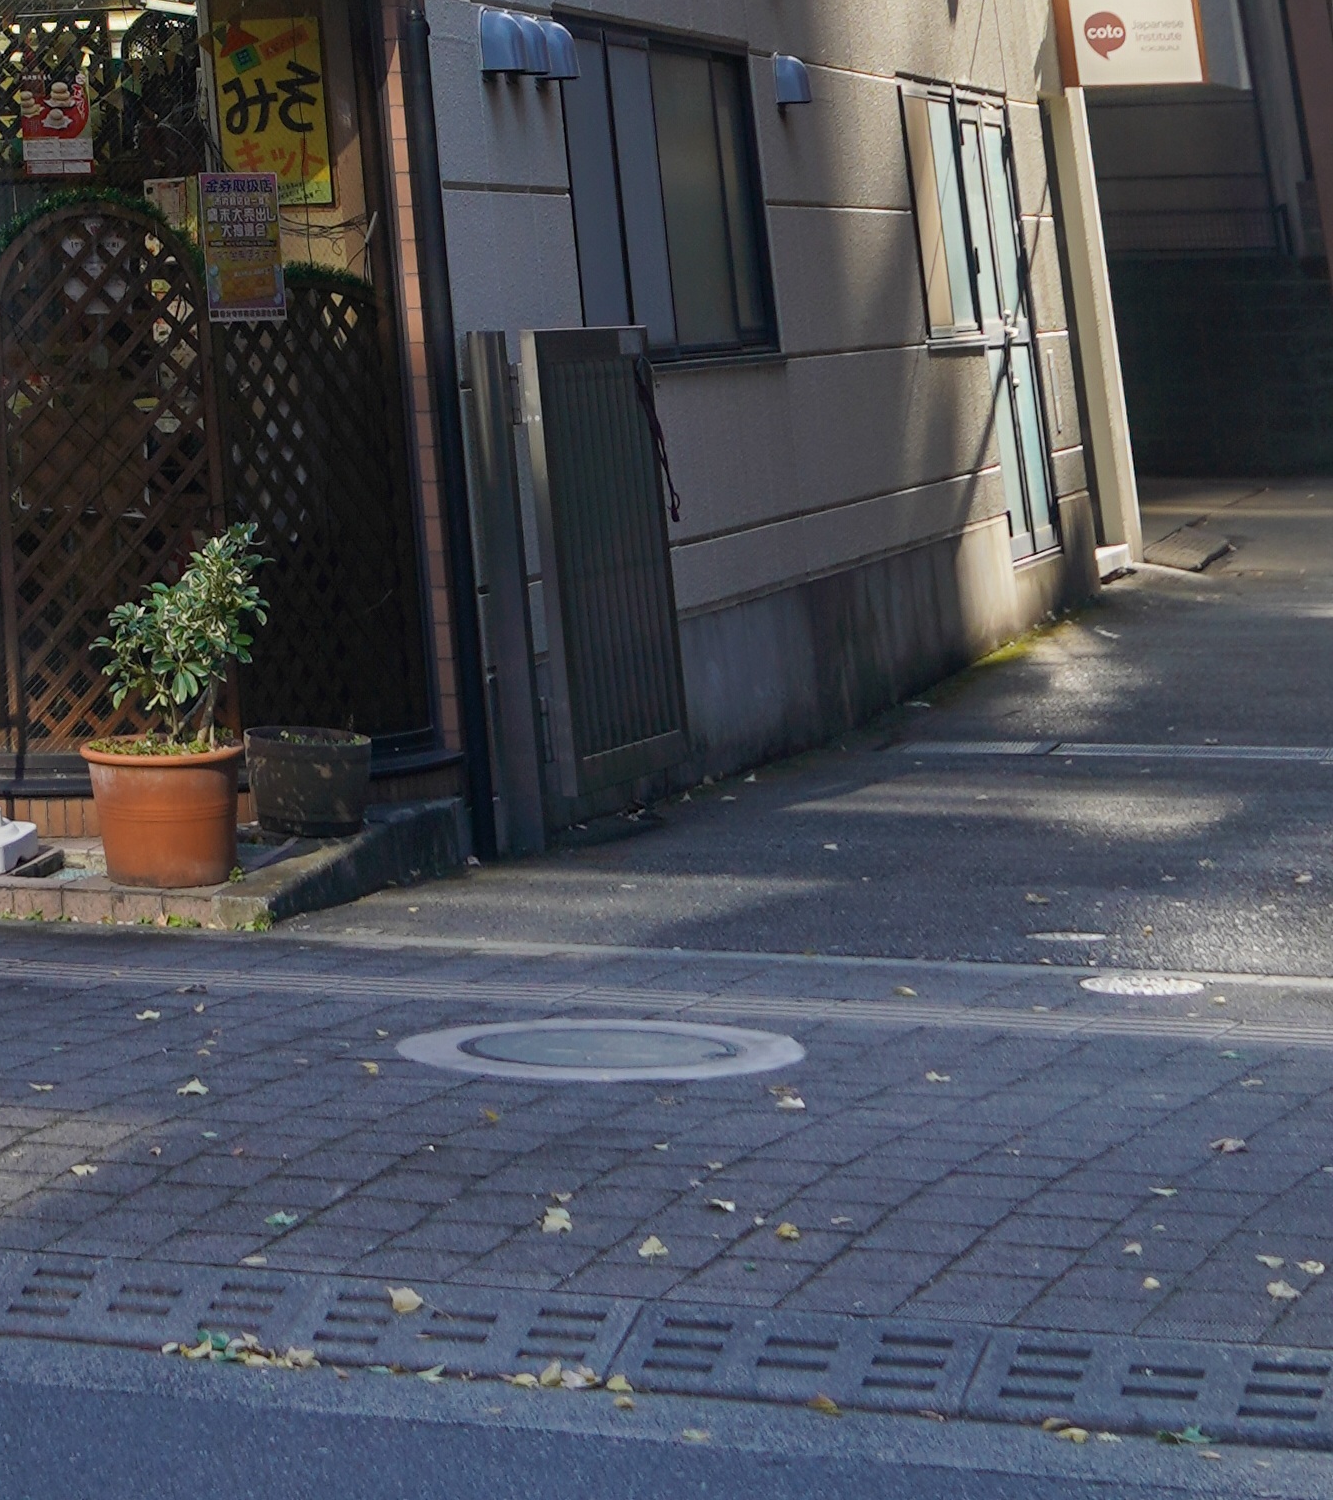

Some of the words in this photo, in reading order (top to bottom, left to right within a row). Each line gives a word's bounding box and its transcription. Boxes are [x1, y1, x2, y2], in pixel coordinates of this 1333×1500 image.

[1086, 23, 1124, 39] coto
[1131, 19, 1185, 30] Japanese
[1136, 31, 1183, 41] Institute
[222, 60, 321, 137] みそ
[235, 137, 325, 177] キット
